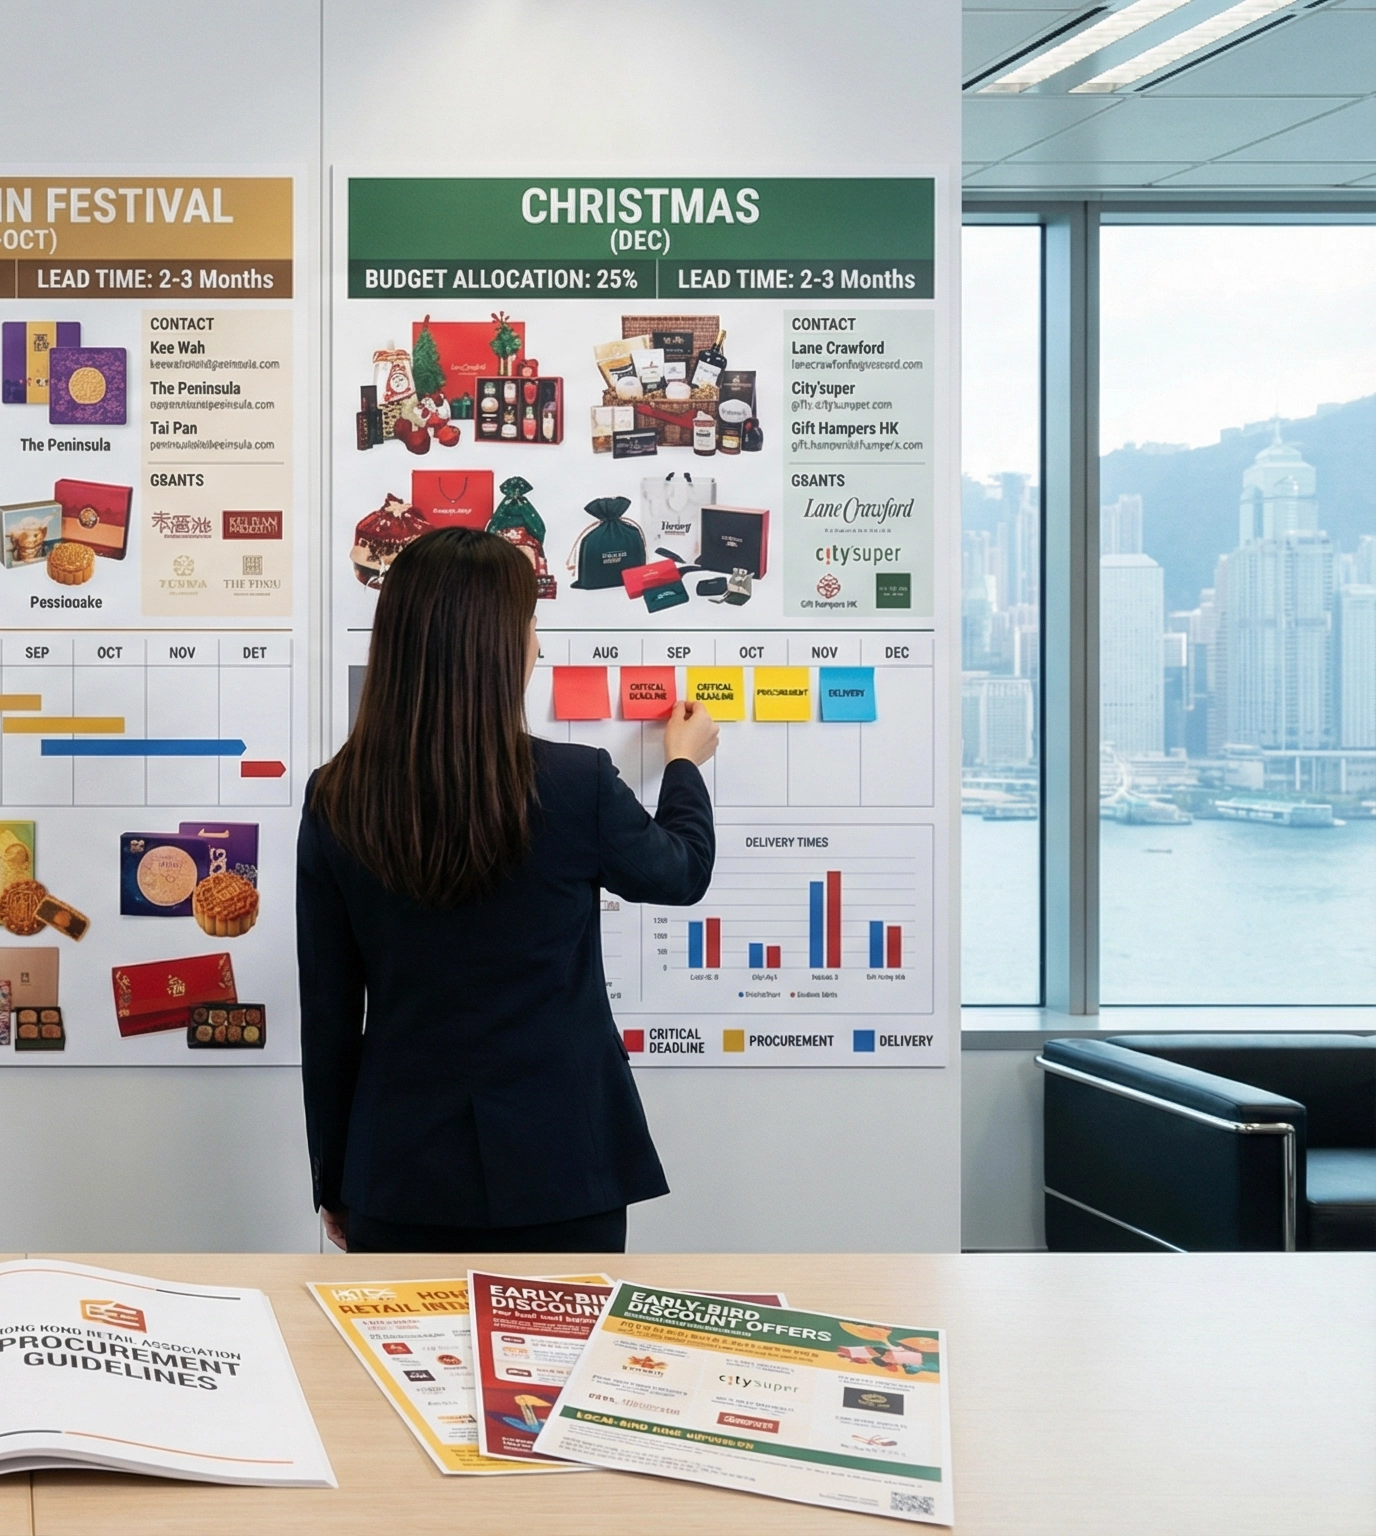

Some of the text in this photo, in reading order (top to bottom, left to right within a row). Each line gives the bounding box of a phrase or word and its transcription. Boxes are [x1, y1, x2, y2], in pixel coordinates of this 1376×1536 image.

[46, 187, 234, 224] FESTIVAL
[521, 187, 760, 224] CHRISTMAS
[610, 229, 670, 255] (DEC)
[37, 269, 274, 290] LEAD TIME: 2-3 Months
[365, 269, 638, 290] BUDGET ALLOCATION: 25%
[678, 269, 915, 290] LEAD TIME: 2-3 Months
[150, 318, 214, 330] CONTACT
[792, 318, 856, 330] CONTACT
[150, 341, 205, 354] Kee Wah
[792, 340, 885, 354] Lane Crawford
[150, 381, 241, 395] The Peninsula
[792, 381, 856, 398] City'super
[150, 421, 197, 434] Tai Pan
[792, 421, 899, 437] Gift Hampers HK
[21, 438, 111, 452] The Peninsula
[803, 497, 915, 524] Lane Crawford
[25, 647, 50, 659] SEP
[97, 647, 123, 659] OCT
[169, 647, 196, 659] NOV
[593, 647, 618, 659] AUG
[667, 647, 691, 659] SEP
[740, 647, 764, 659] OCT
[812, 647, 838, 659] NOV
[885, 647, 909, 659] DEC
[745, 837, 829, 848] DELIVERY TIMES
[649, 1028, 701, 1040] CRITICAL
[749, 1035, 834, 1047] PROCUREMENT
[879, 1035, 933, 1047] DELIVERY
[649, 1042, 705, 1054] DEADLINE
[338, 1303, 421, 1315] RETAIL
[491, 1296, 603, 1316] DISCOUN
[632, 1291, 760, 1321] EARLY-BIRD
[628, 1301, 742, 1328] DISCOUNT
[746, 1321, 832, 1342] OFFERS
[24, 1351, 218, 1391] GUIDELINES
